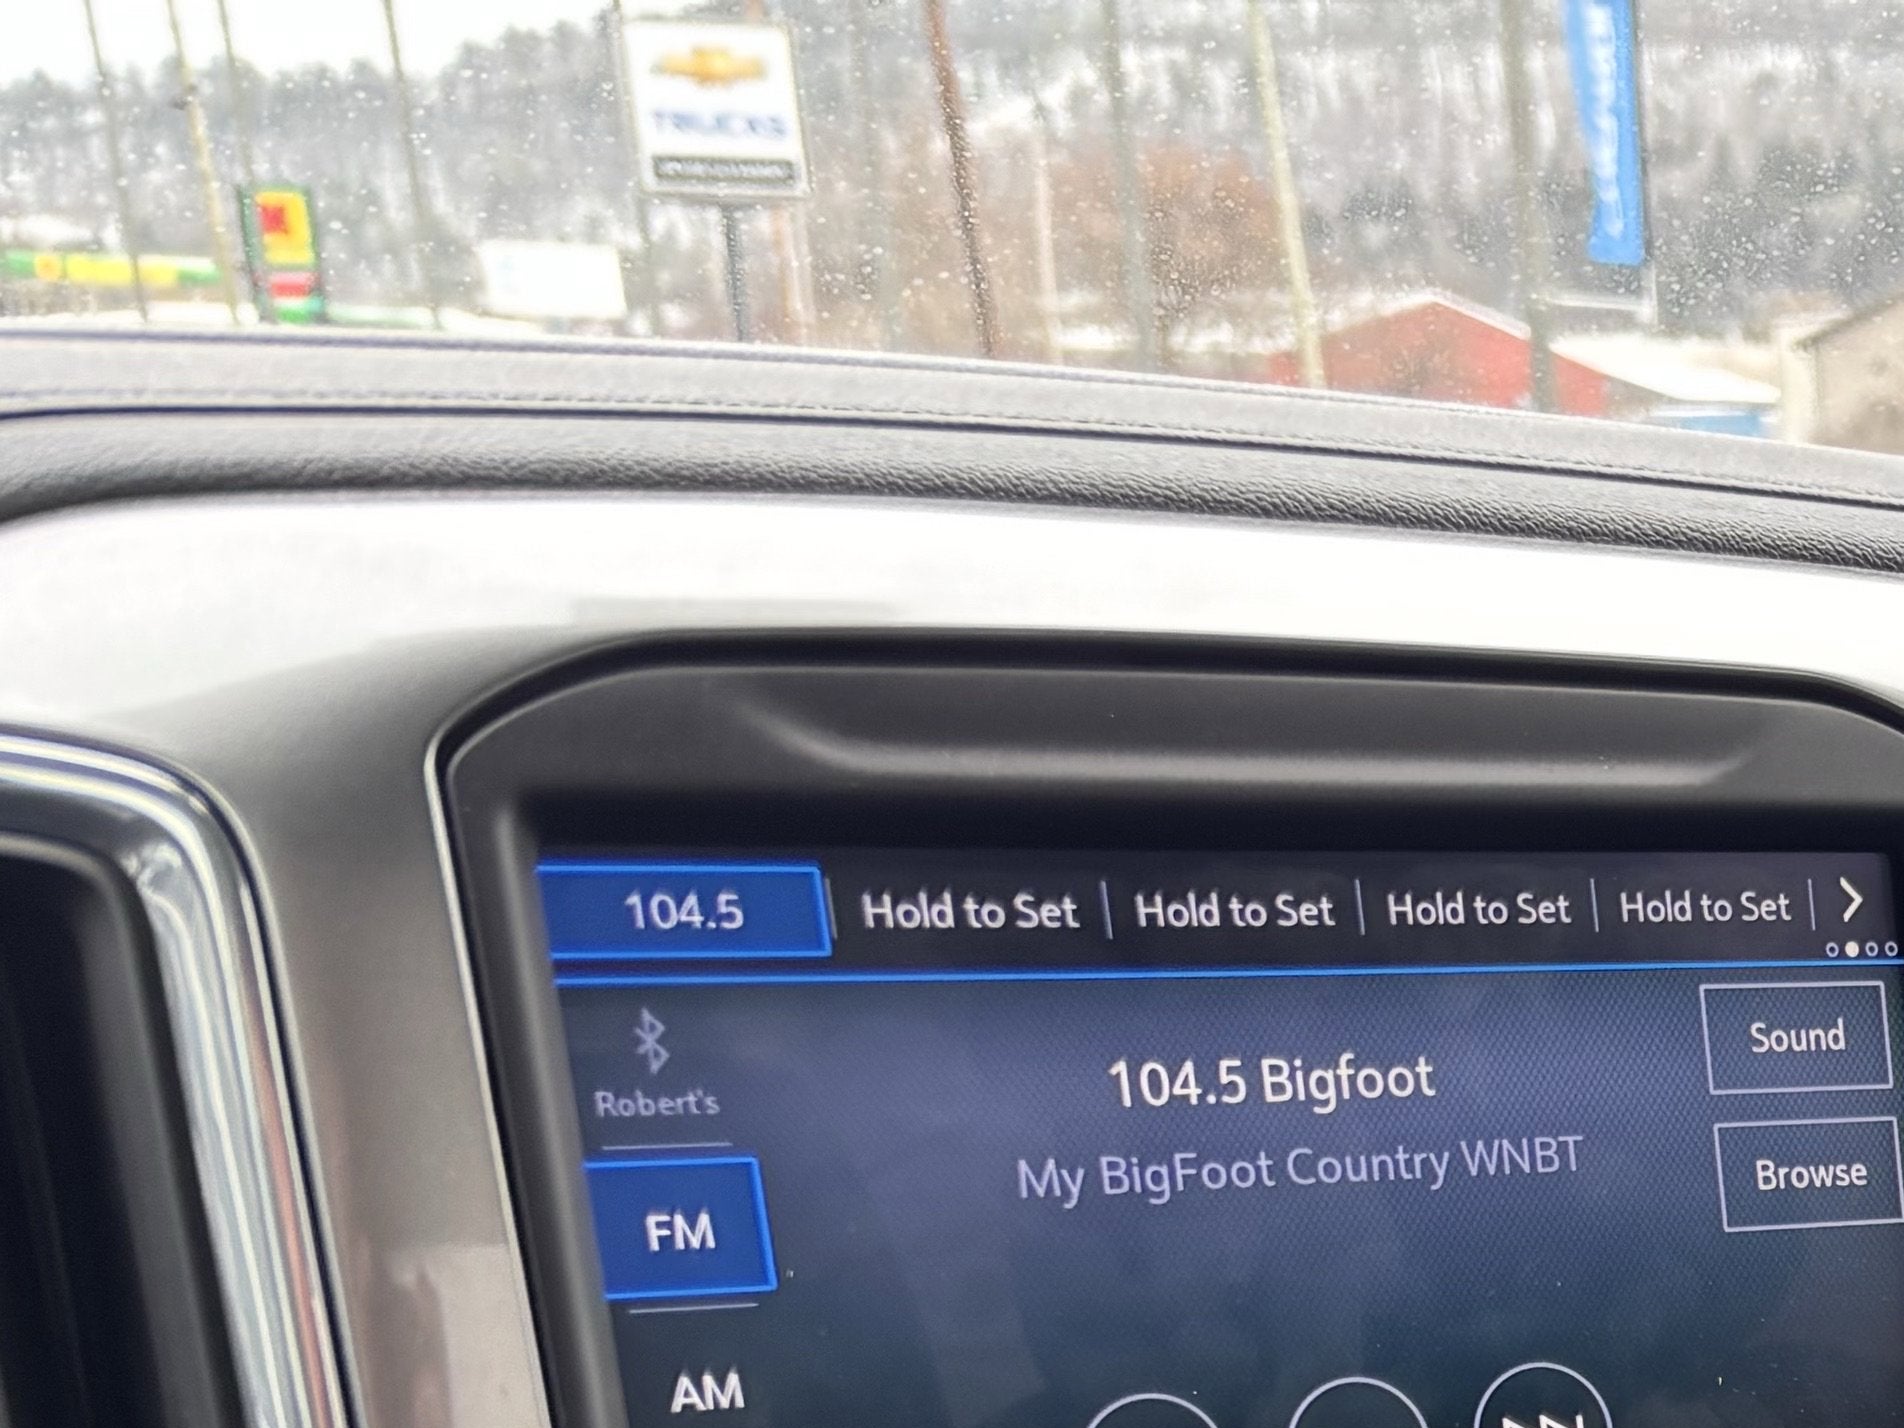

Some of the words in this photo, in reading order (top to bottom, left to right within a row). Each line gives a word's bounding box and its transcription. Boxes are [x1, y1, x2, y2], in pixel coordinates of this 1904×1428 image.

[624, 890, 745, 930] 104.5
[862, 889, 955, 929] Hold
[966, 895, 1006, 929] to
[1013, 892, 1081, 929] Set
[1135, 890, 1221, 929] Hold
[1231, 897, 1269, 927] to
[1275, 893, 1336, 927] Set
[1387, 890, 1464, 925] Hold
[1472, 897, 1509, 924] to
[1516, 892, 1572, 924] Set
[1619, 889, 1692, 923] Hold
[1699, 895, 1734, 922] to
[1739, 891, 1792, 921] Set
[1749, 1018, 1846, 1053] Sound
[1107, 1058, 1247, 1108] 104.5
[1260, 1052, 1437, 1115] Bigfoot
[594, 1090, 721, 1118] Robert's
[1017, 1157, 1086, 1210] My
[1100, 1151, 1277, 1206] BigFoot
[1286, 1143, 1451, 1191] Country
[1460, 1135, 1584, 1177] WNBT
[1755, 1158, 1868, 1191] Browse
[645, 1209, 716, 1252] FM
[669, 1369, 745, 1413] AM
